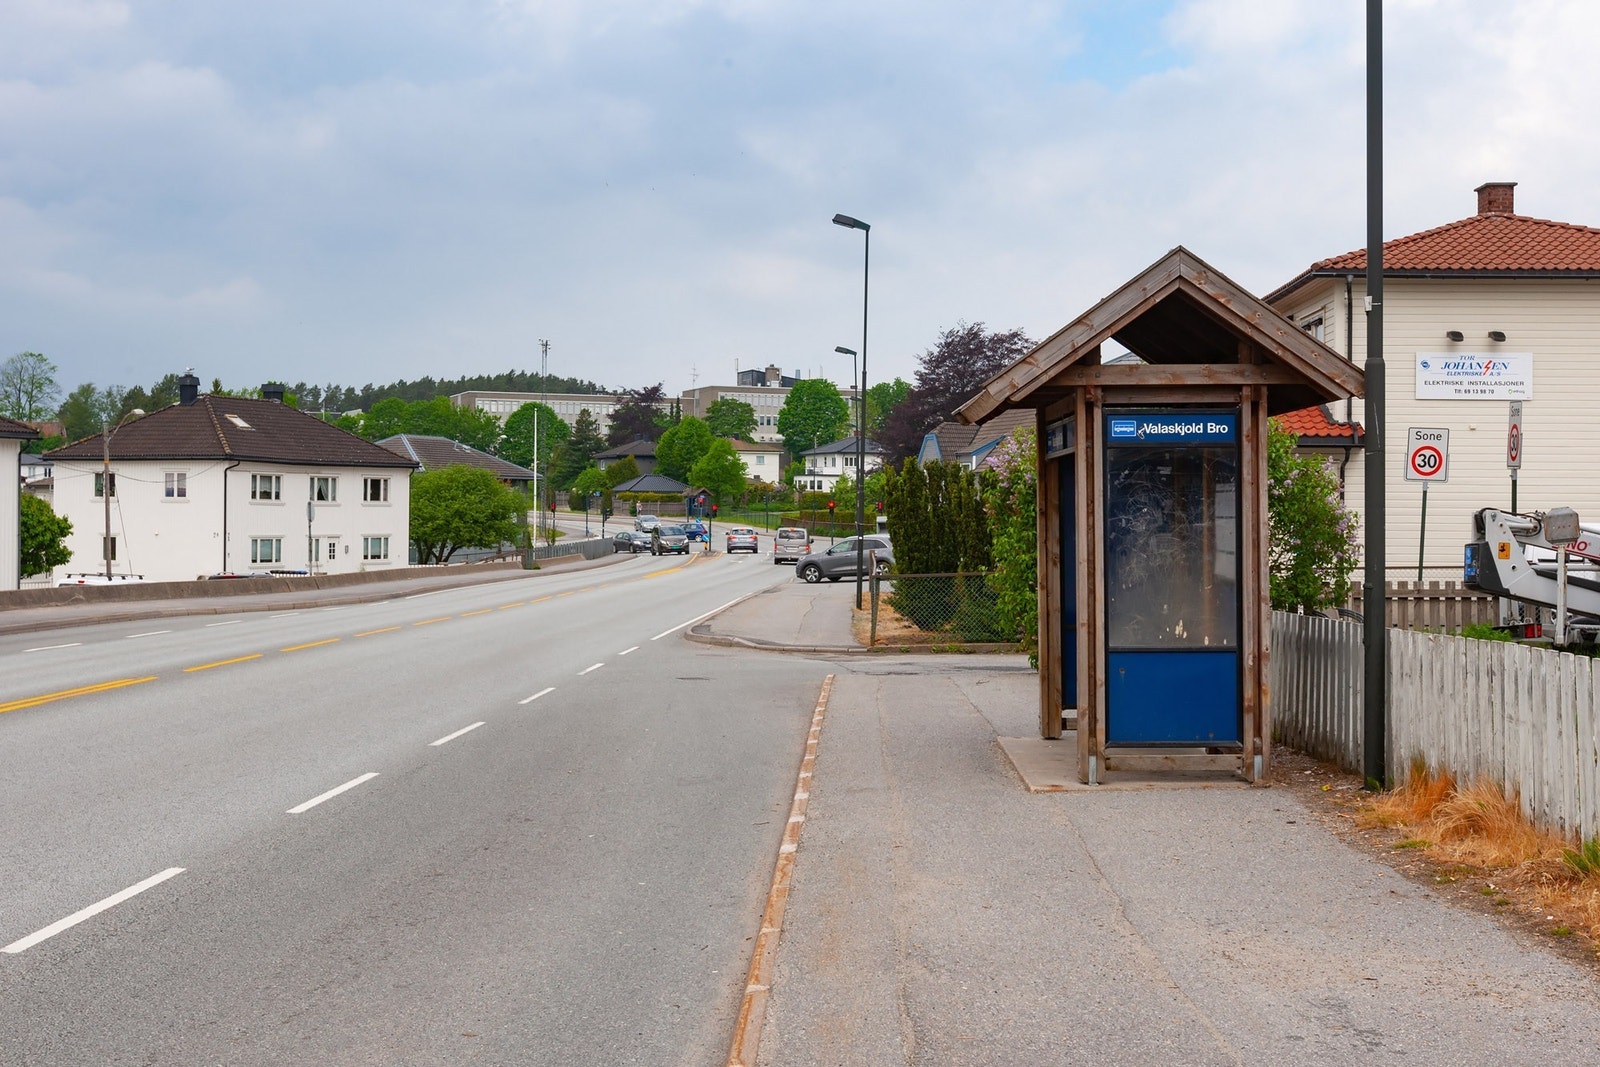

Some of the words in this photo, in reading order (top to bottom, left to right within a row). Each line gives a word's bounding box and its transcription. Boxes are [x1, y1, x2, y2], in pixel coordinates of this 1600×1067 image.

[1143, 422, 1203, 435] Valaskjold
[1207, 422, 1228, 433] Bro
[1415, 430, 1441, 440] Sone
[1417, 453, 1437, 469] 30
